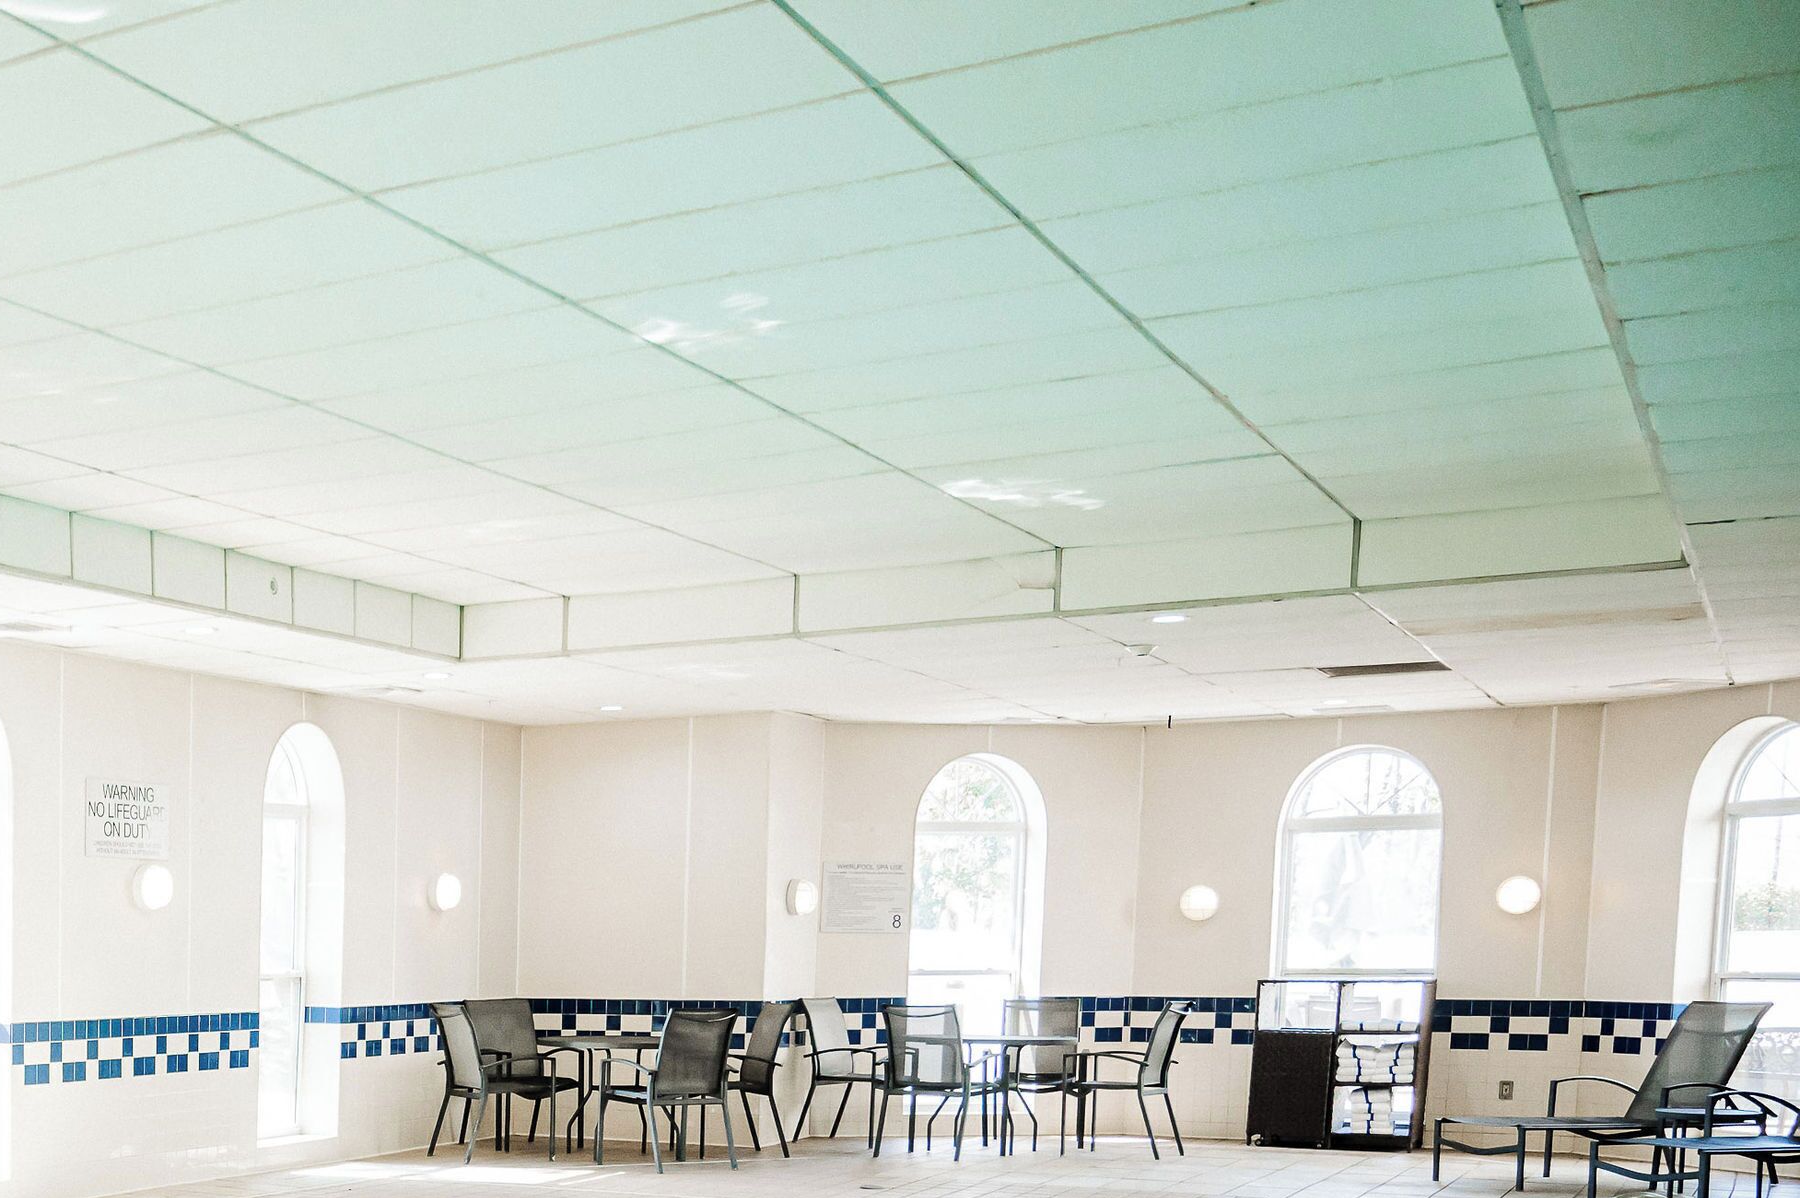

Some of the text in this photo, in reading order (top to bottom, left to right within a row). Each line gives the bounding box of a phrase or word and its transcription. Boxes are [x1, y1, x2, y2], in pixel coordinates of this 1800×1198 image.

[102, 784, 155, 803] WARNING
[88, 801, 105, 818] NO
[103, 821, 121, 837] ON
[892, 914, 901, 928] 8
